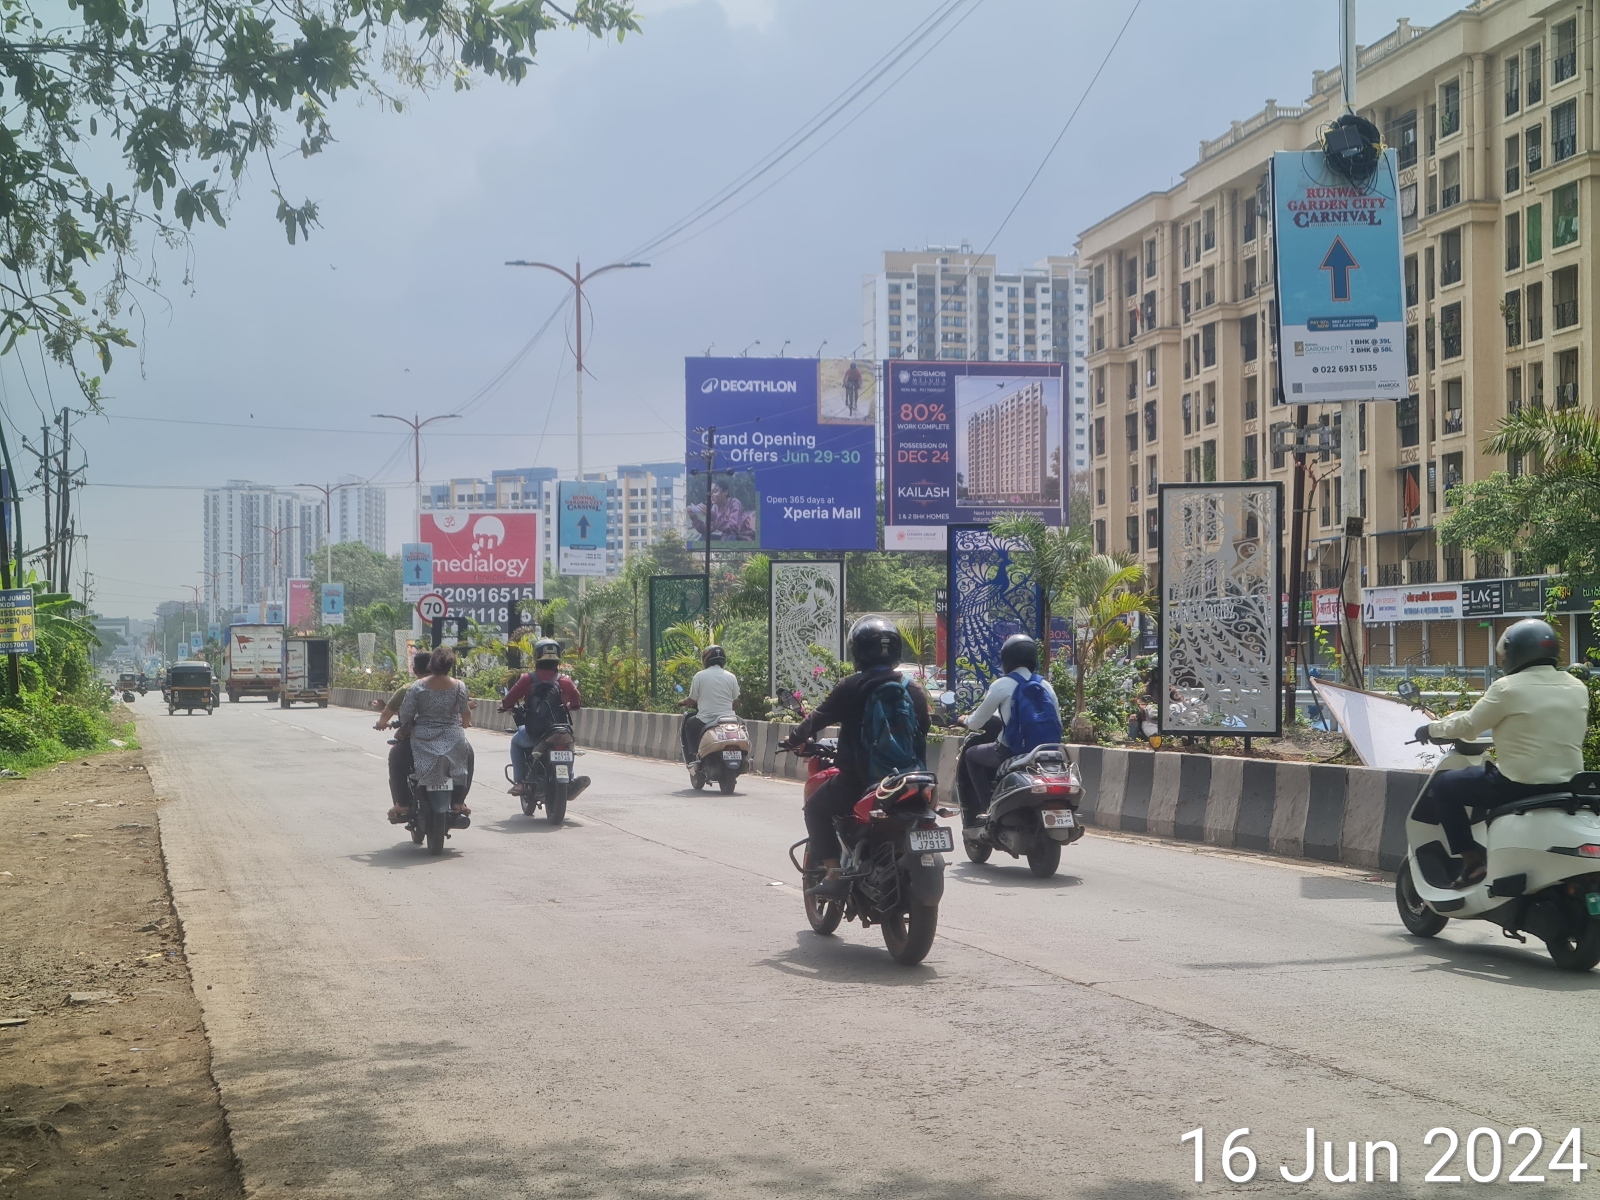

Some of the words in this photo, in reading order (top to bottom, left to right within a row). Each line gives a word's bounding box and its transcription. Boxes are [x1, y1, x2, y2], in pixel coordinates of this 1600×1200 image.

[1306, 187, 1366, 199] RUNWAL
[1287, 199, 1348, 211] GARDEN
[1352, 198, 1386, 209] CITY
[1293, 210, 1381, 228] CARNIVAL
[1359, 364, 1378, 372] 5135
[720, 379, 797, 393] DECATHLON
[900, 403, 946, 421] 80%
[701, 431, 748, 446] Grand
[752, 431, 815, 448] Opening
[730, 448, 778, 462] Offers
[782, 450, 810, 463] Jun
[814, 450, 861, 463] 29-30
[898, 450, 928, 463] DEC
[932, 450, 949, 463] 24
[898, 486, 950, 498] KAILASH
[766, 496, 788, 505] Open
[789, 495, 805, 504] 365
[806, 495, 825, 505] days
[826, 496, 835, 504] at
[567, 504, 601, 512] CARNIVAL
[783, 506, 829, 521] Xperia
[832, 507, 861, 519] Mall
[432, 552, 529, 577] medialogy
[424, 602, 442, 615] 70
[916, 830, 945, 841] MH03E
[918, 840, 947, 850] J7913
